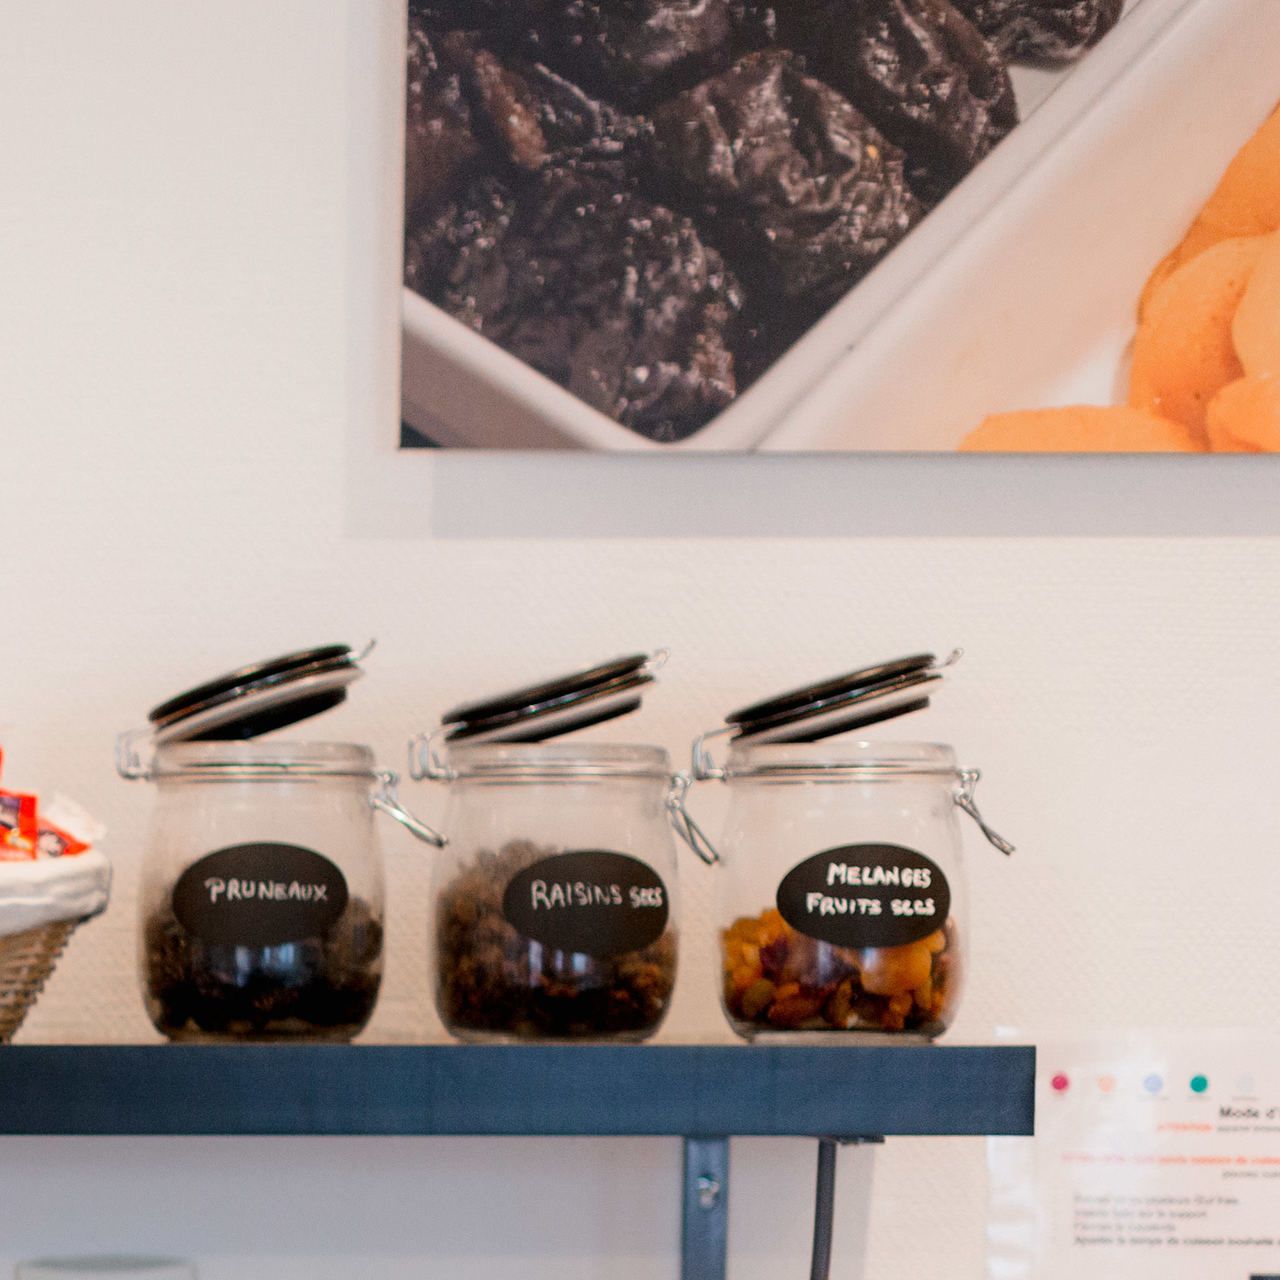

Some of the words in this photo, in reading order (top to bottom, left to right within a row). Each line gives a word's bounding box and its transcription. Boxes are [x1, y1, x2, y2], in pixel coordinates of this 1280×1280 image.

[826, 862, 932, 889] MELANGES
[204, 876, 329, 904] PRUNEAUX
[805, 891, 882, 916] FRUITS
